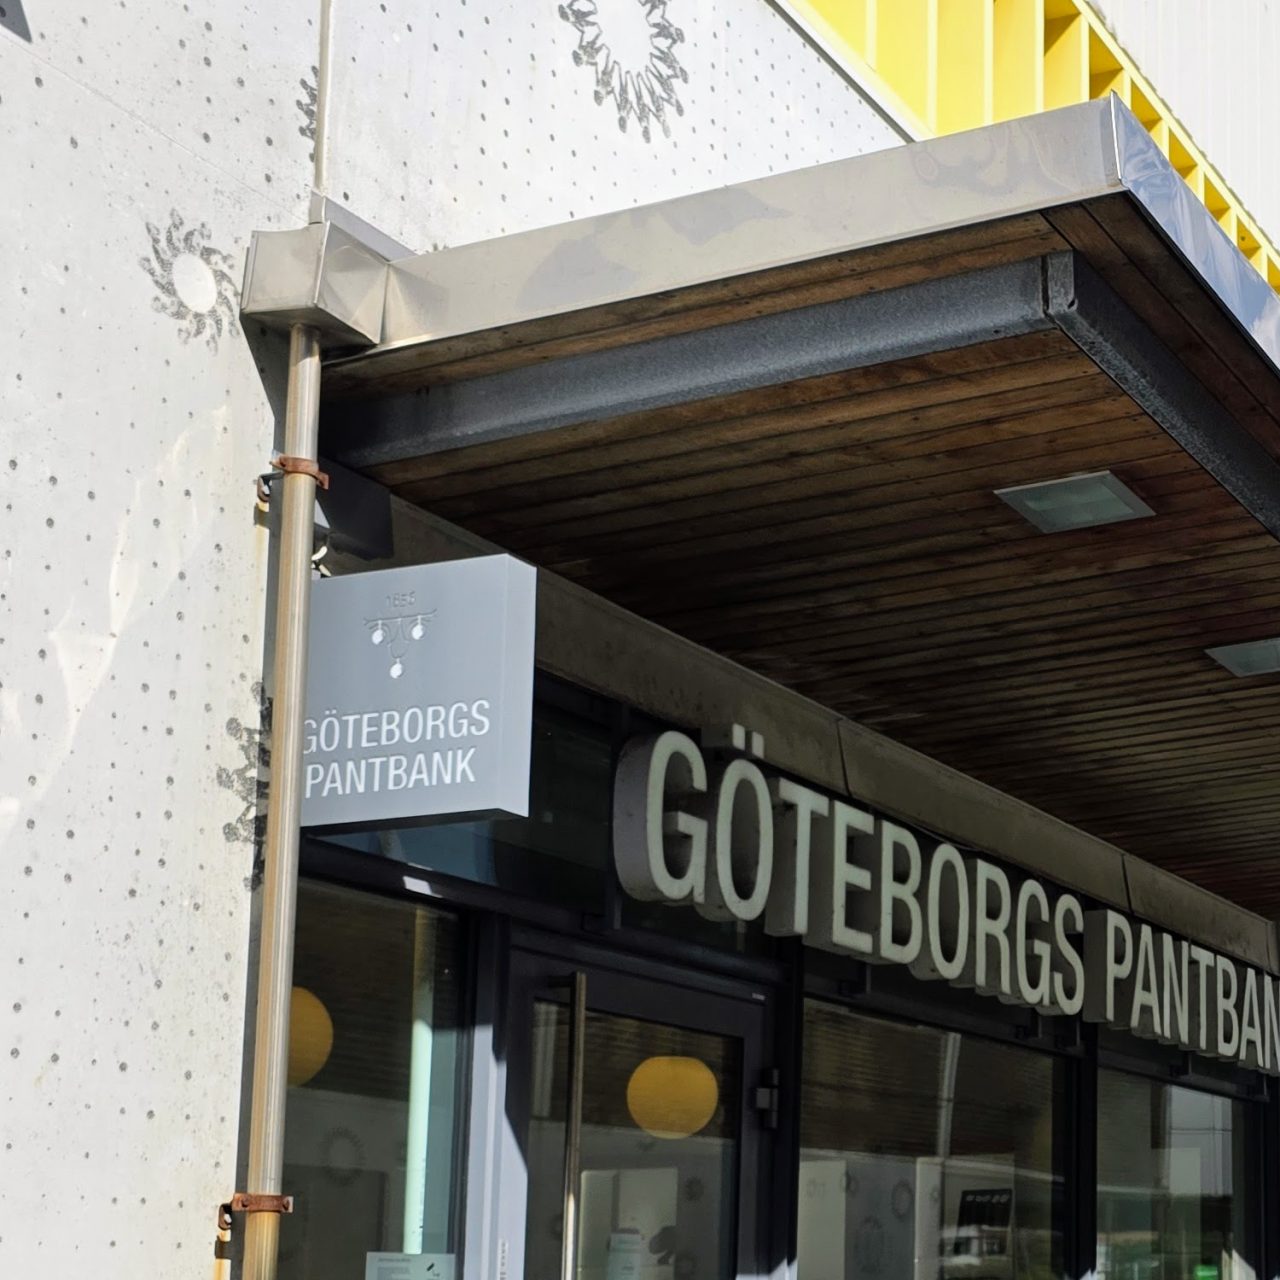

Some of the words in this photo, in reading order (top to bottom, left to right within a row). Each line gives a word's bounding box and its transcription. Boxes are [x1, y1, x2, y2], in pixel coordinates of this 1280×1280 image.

[303, 700, 490, 754] GÖTEBORGS
[304, 748, 476, 799] PANTBANK
[646, 723, 1084, 1016] GÖTEBORGS
